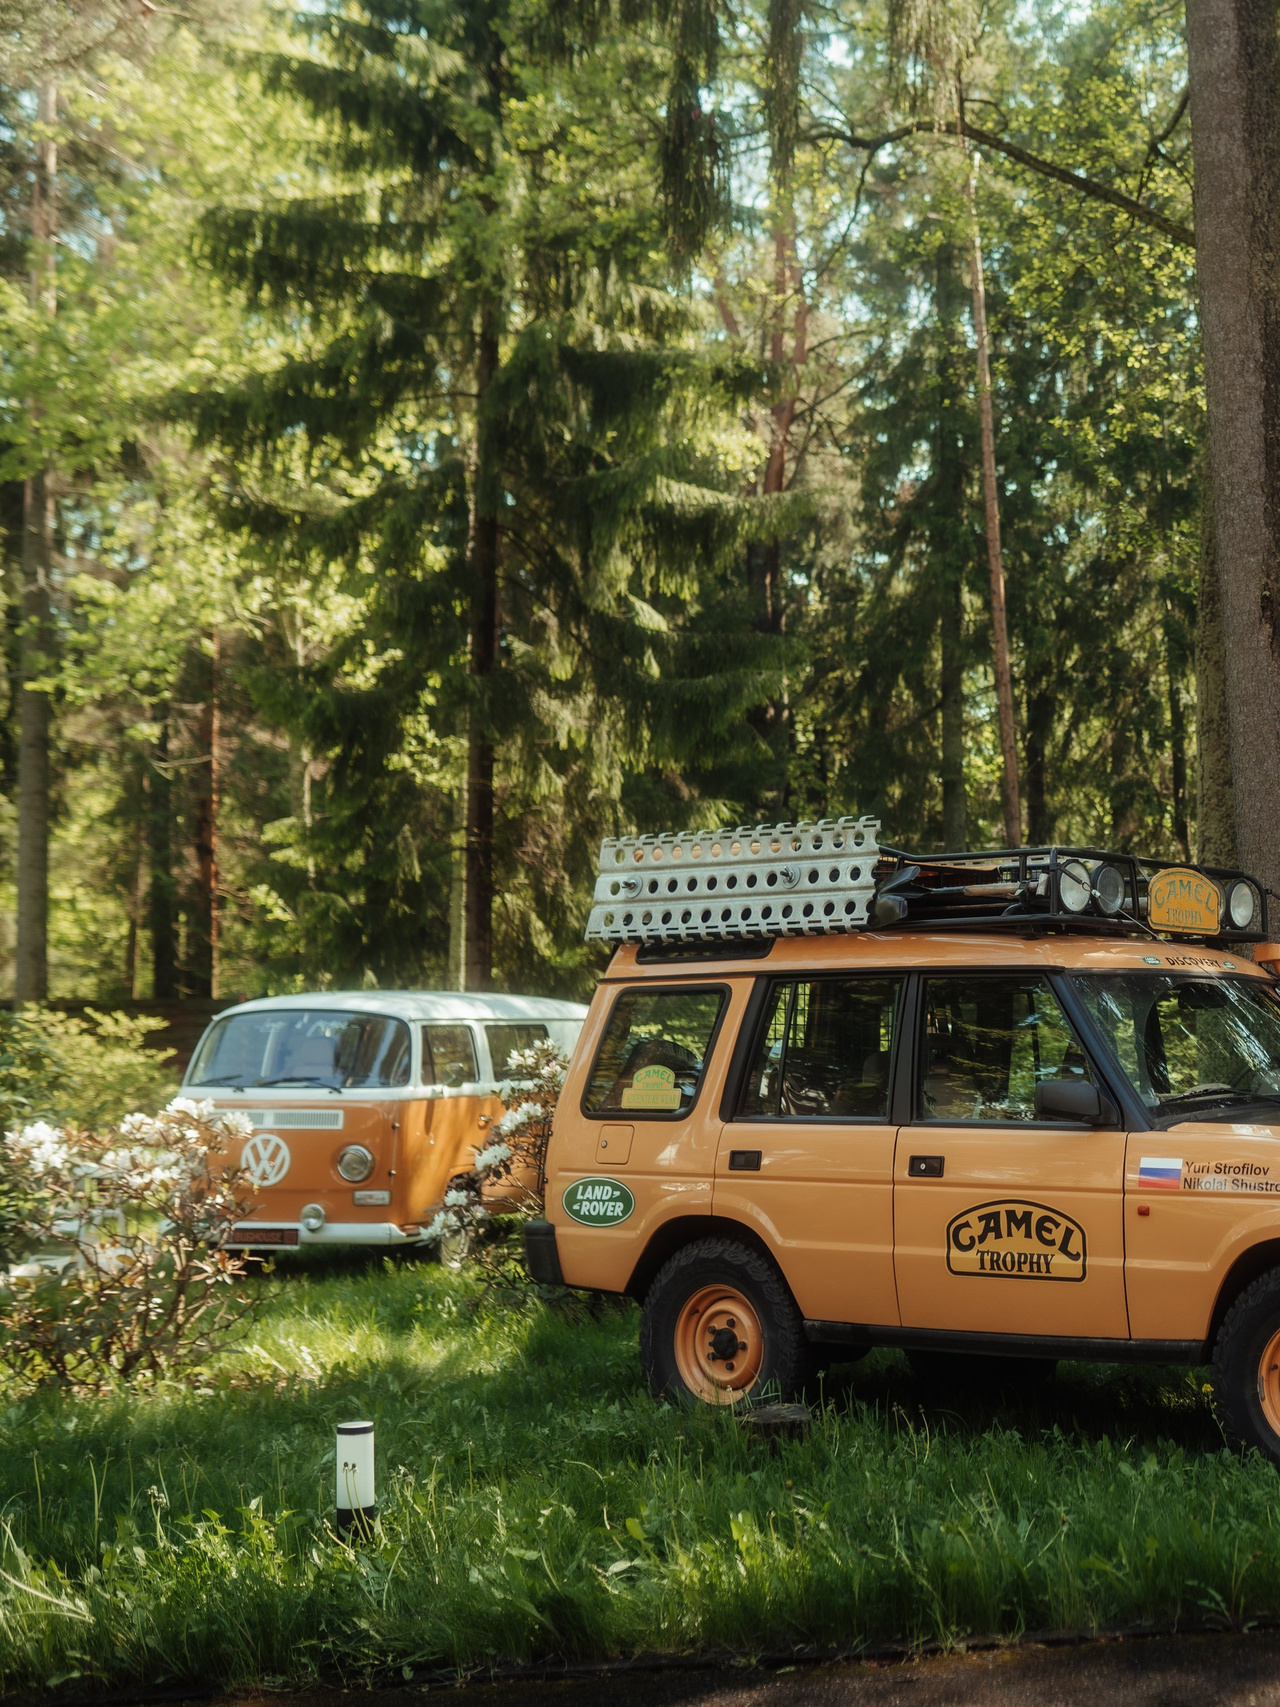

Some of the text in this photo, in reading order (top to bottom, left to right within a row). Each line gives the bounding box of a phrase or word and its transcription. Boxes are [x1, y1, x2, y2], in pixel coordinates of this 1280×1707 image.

[1154, 879, 1215, 914] CAMEL
[1166, 907, 1203, 925] TROPHY
[1165, 956, 1221, 968] DISCOVERY
[635, 1069, 672, 1084] CAMEL
[1186, 1161, 1270, 1176] Yuri Strofilov
[1183, 1177, 1227, 1190] Nikolai
[576, 1185, 613, 1200] LAND
[579, 1201, 624, 1216] ROVER
[952, 1209, 1081, 1261] CAMEL
[976, 1249, 1055, 1274] TROPHY
